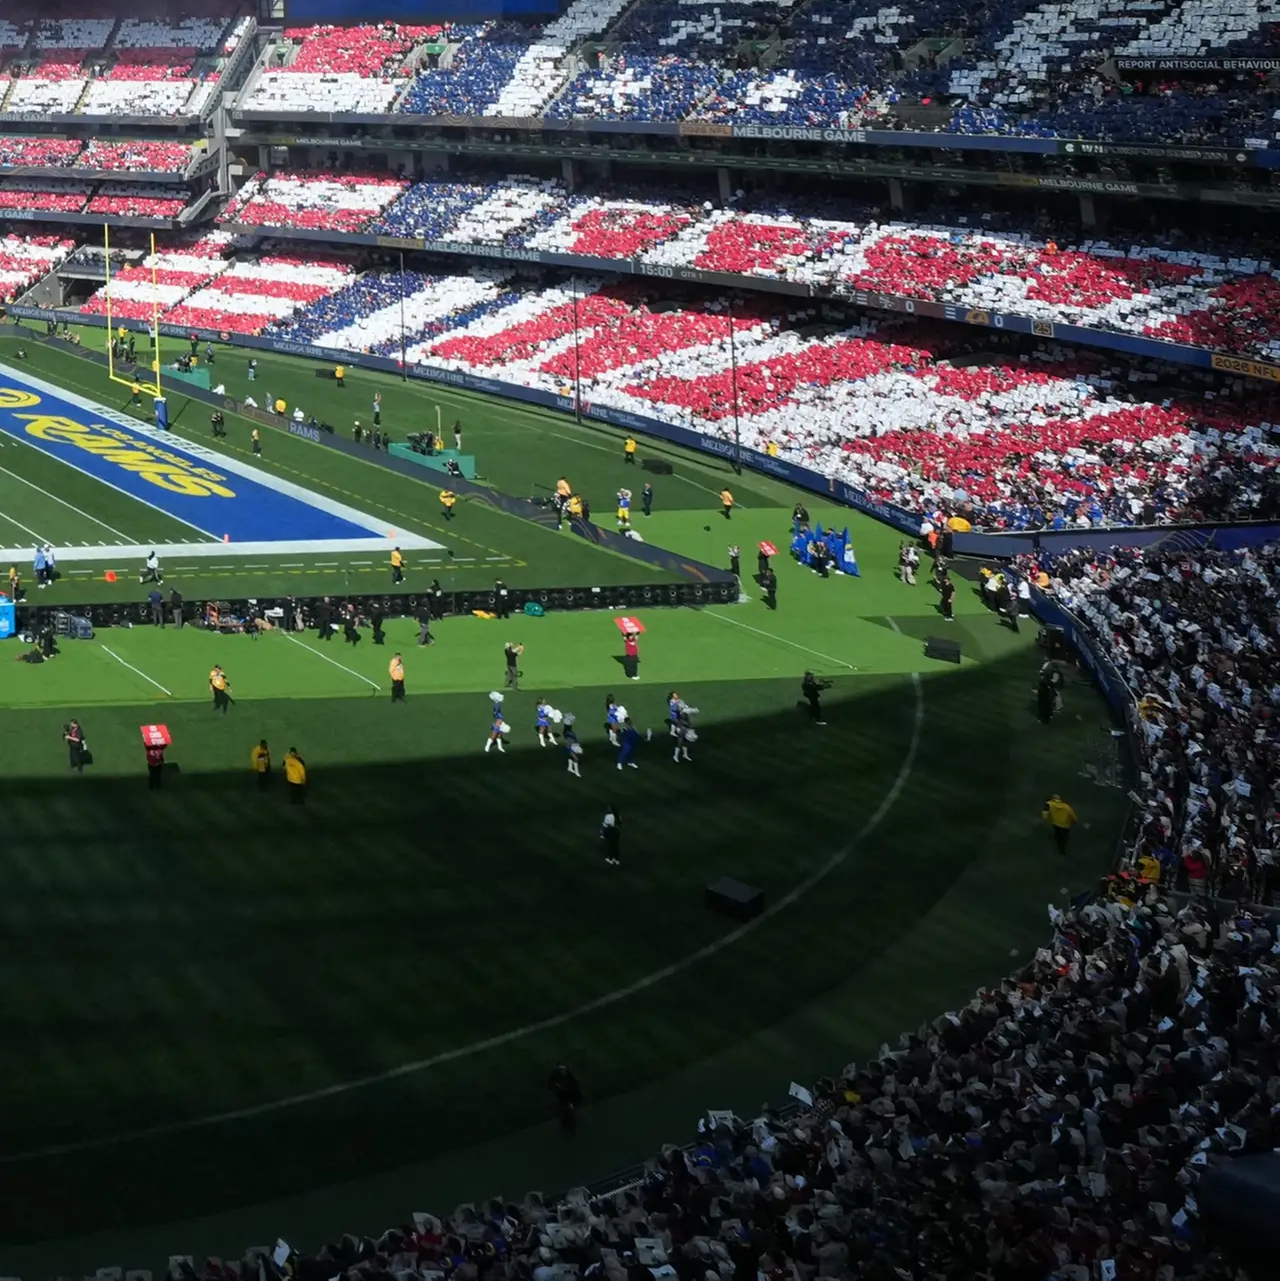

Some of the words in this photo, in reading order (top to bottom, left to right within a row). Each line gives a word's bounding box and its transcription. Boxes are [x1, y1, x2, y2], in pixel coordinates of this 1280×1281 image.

[1118, 60, 1156, 69] REPORT
[1159, 60, 1221, 69] ANTISOCIAL
[733, 127, 822, 141] MELBOURNE
[823, 131, 867, 143] GAME
[1040, 178, 1104, 191] MELBOURNE
[1105, 182, 1138, 193] GAME
[4, 210, 35, 220] GAME
[640, 264, 674, 278] 15:00
[905, 301, 915, 313] 0
[994, 315, 1004, 328] 0
[1215, 357, 1250, 373] 2026
[1253, 364, 1278, 379] NFL
[289, 422, 320, 442] RAMS
[11, 412, 237, 498] RAMS
[89, 424, 134, 442] LOS
[129, 440, 228, 482] ANGELES
